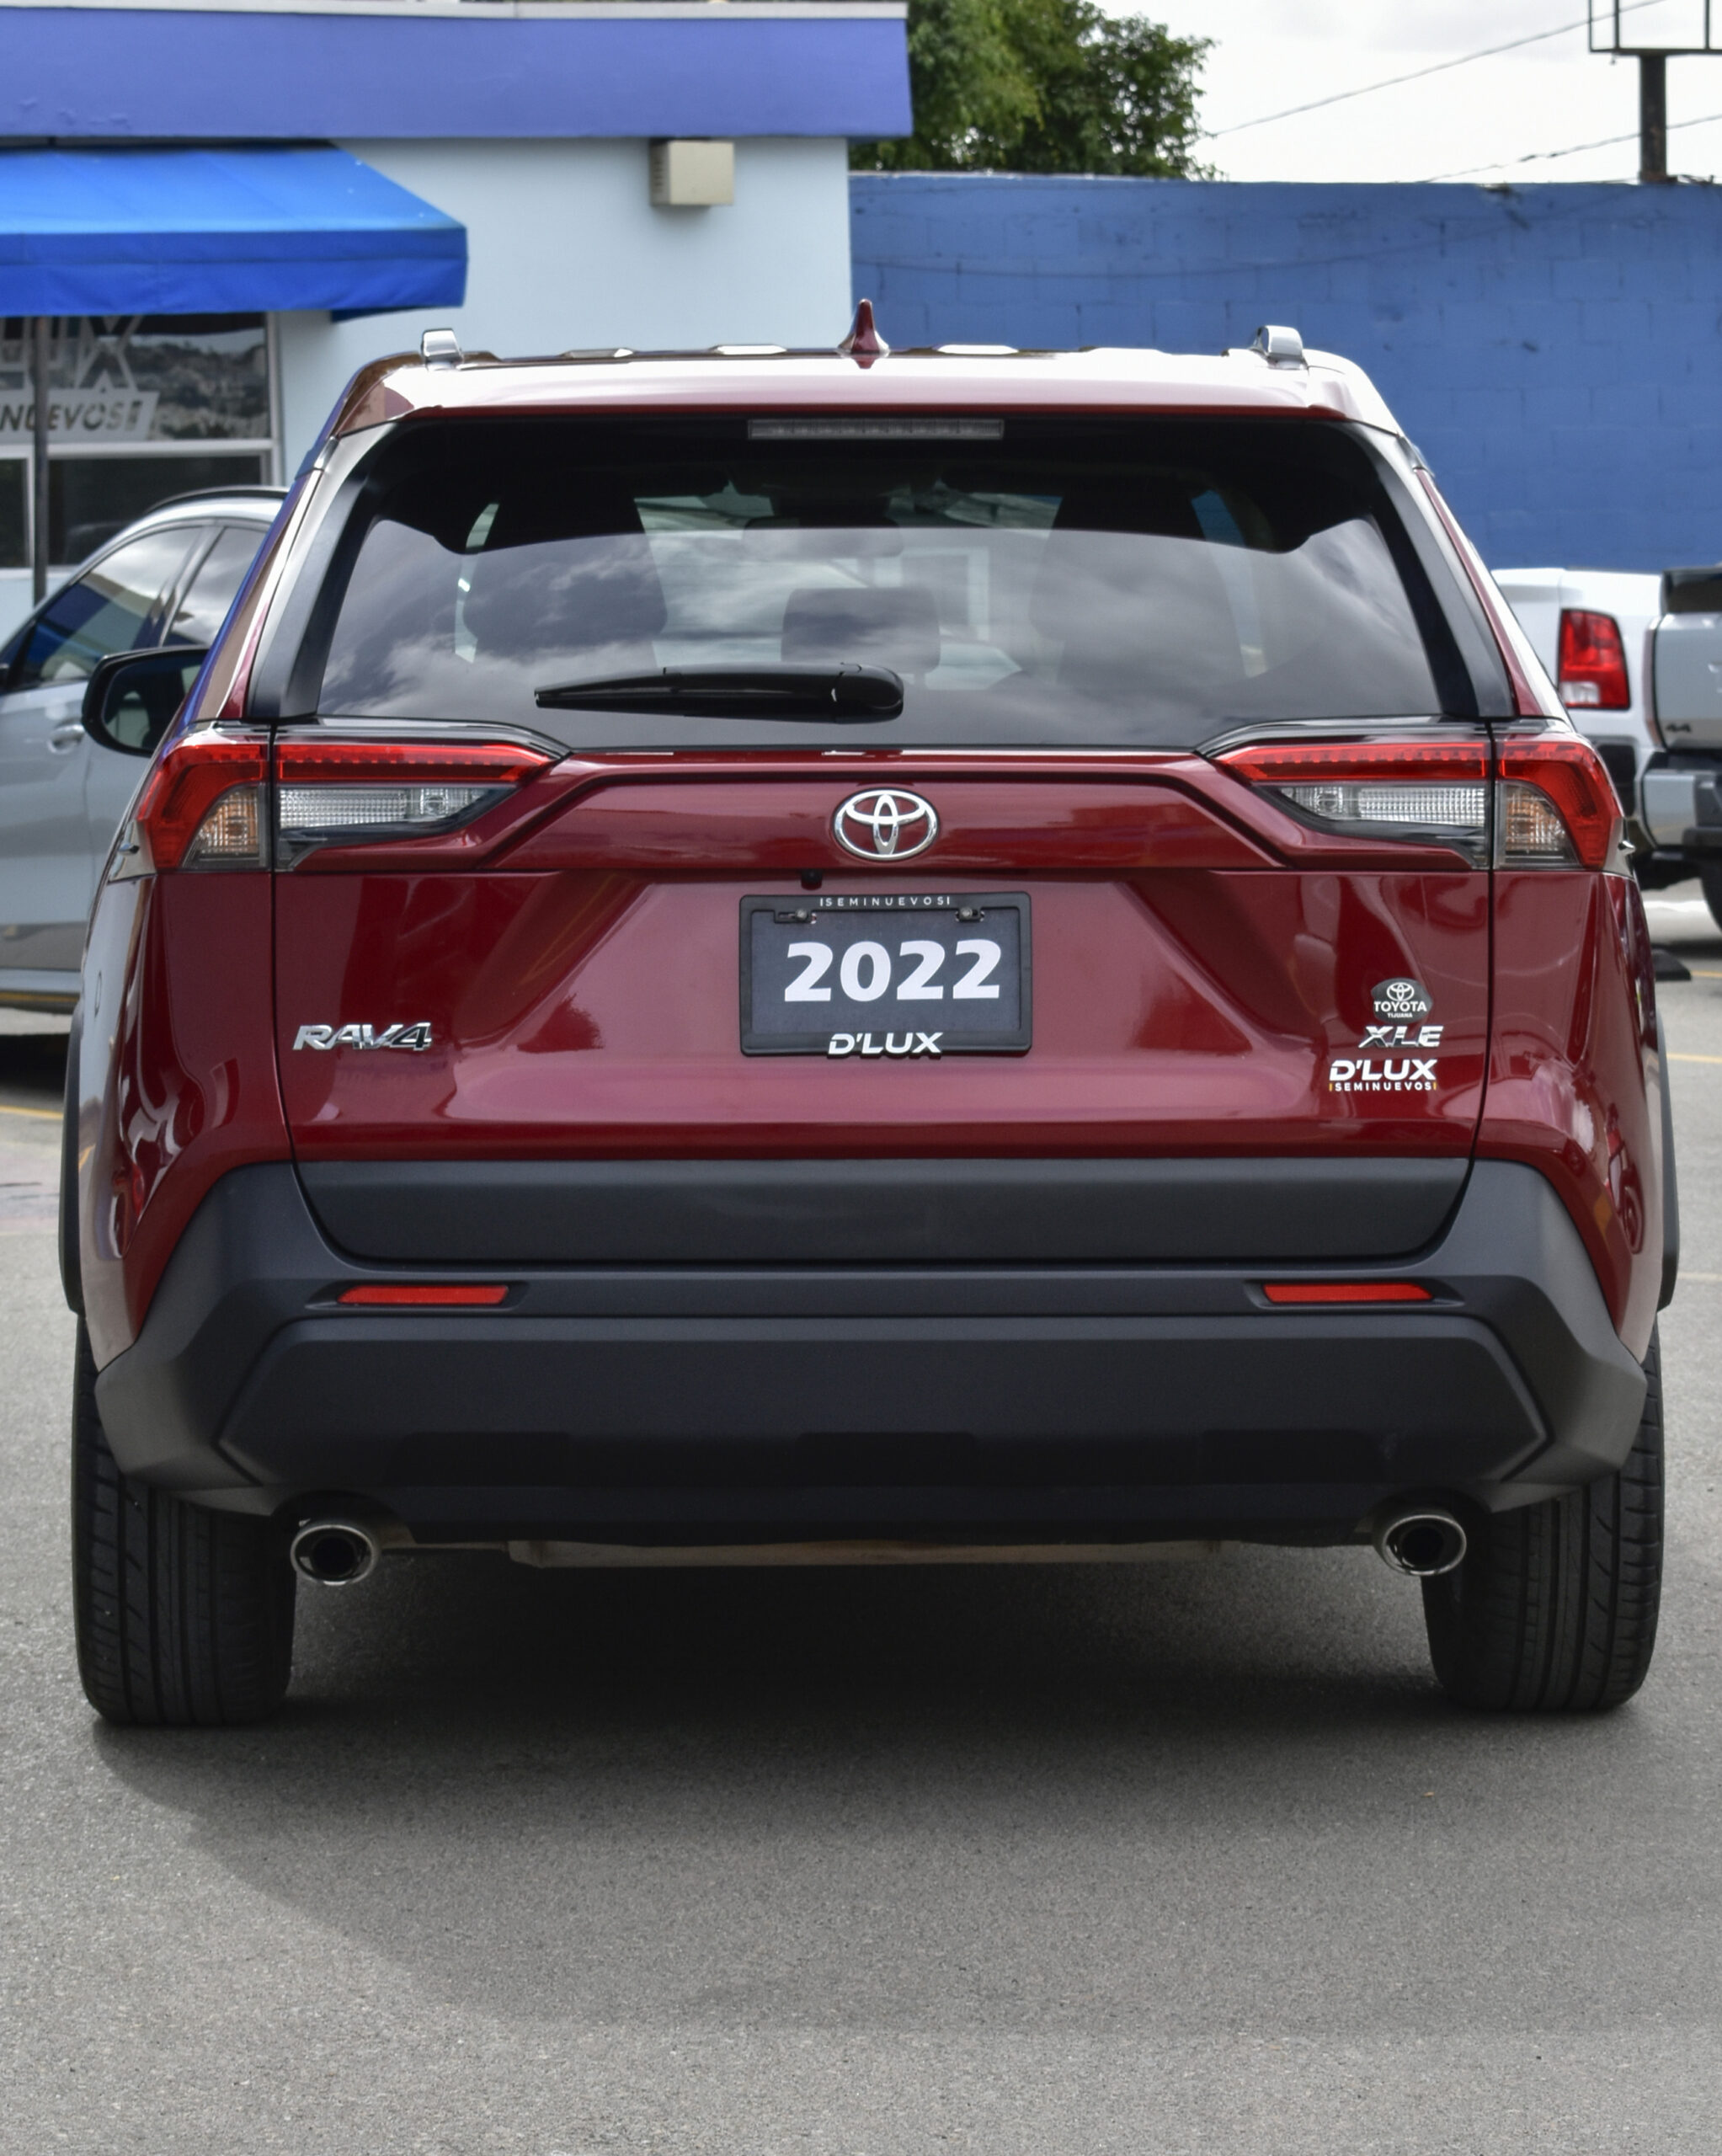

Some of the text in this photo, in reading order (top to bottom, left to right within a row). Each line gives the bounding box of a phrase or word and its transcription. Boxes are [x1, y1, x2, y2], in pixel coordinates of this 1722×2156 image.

[784, 939, 1002, 1002] 2022
[1374, 1001, 1427, 1011] TOYOTA
[292, 1022, 432, 1051] RAV4
[828, 1033, 943, 1054] D'LUX
[1358, 1025, 1444, 1047] XLE
[1329, 1059, 1437, 1081] D'LUX
